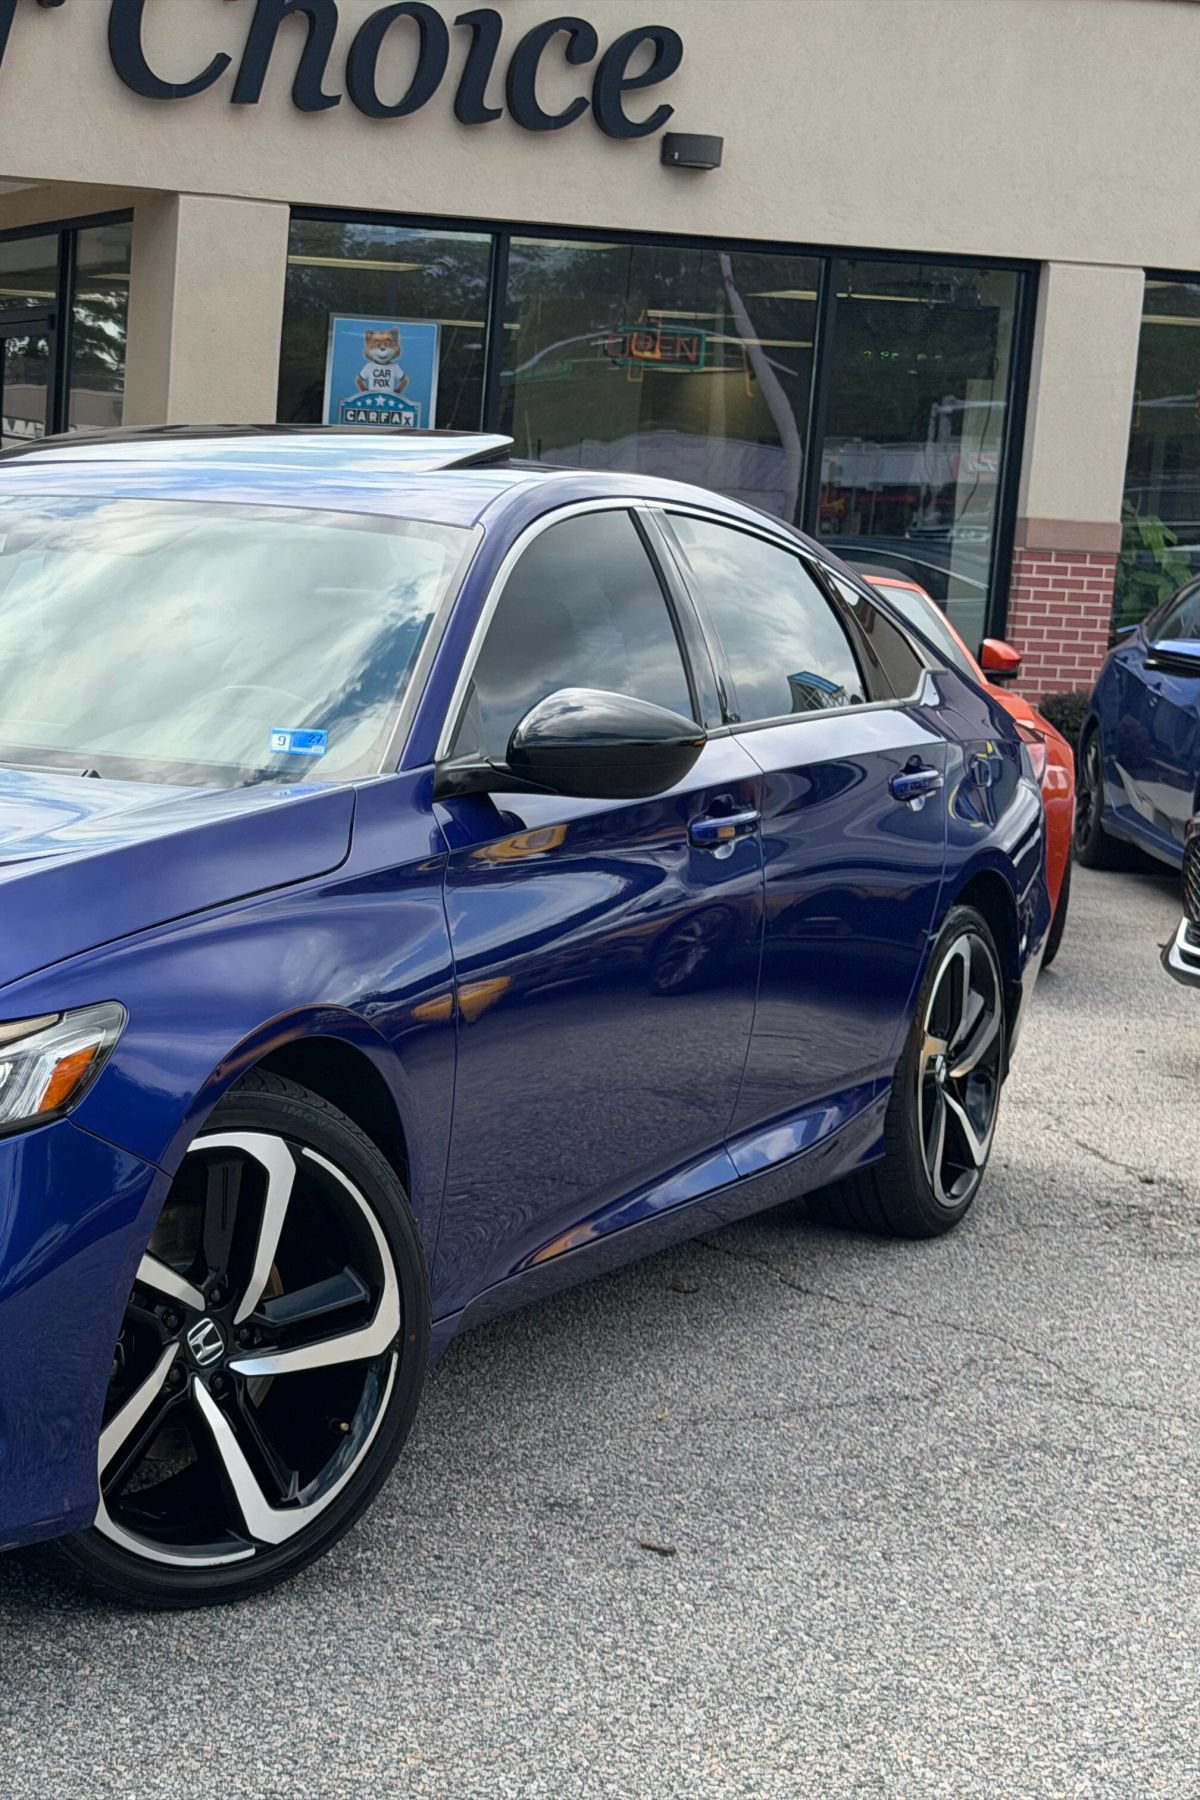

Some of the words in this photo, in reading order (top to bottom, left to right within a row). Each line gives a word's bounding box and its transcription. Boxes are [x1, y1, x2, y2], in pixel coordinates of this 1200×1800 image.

[373, 369, 391, 379] CAR
[373, 379, 390, 387] FOX
[346, 410, 413, 426] CARFAX
[277, 735, 286, 746] 9
